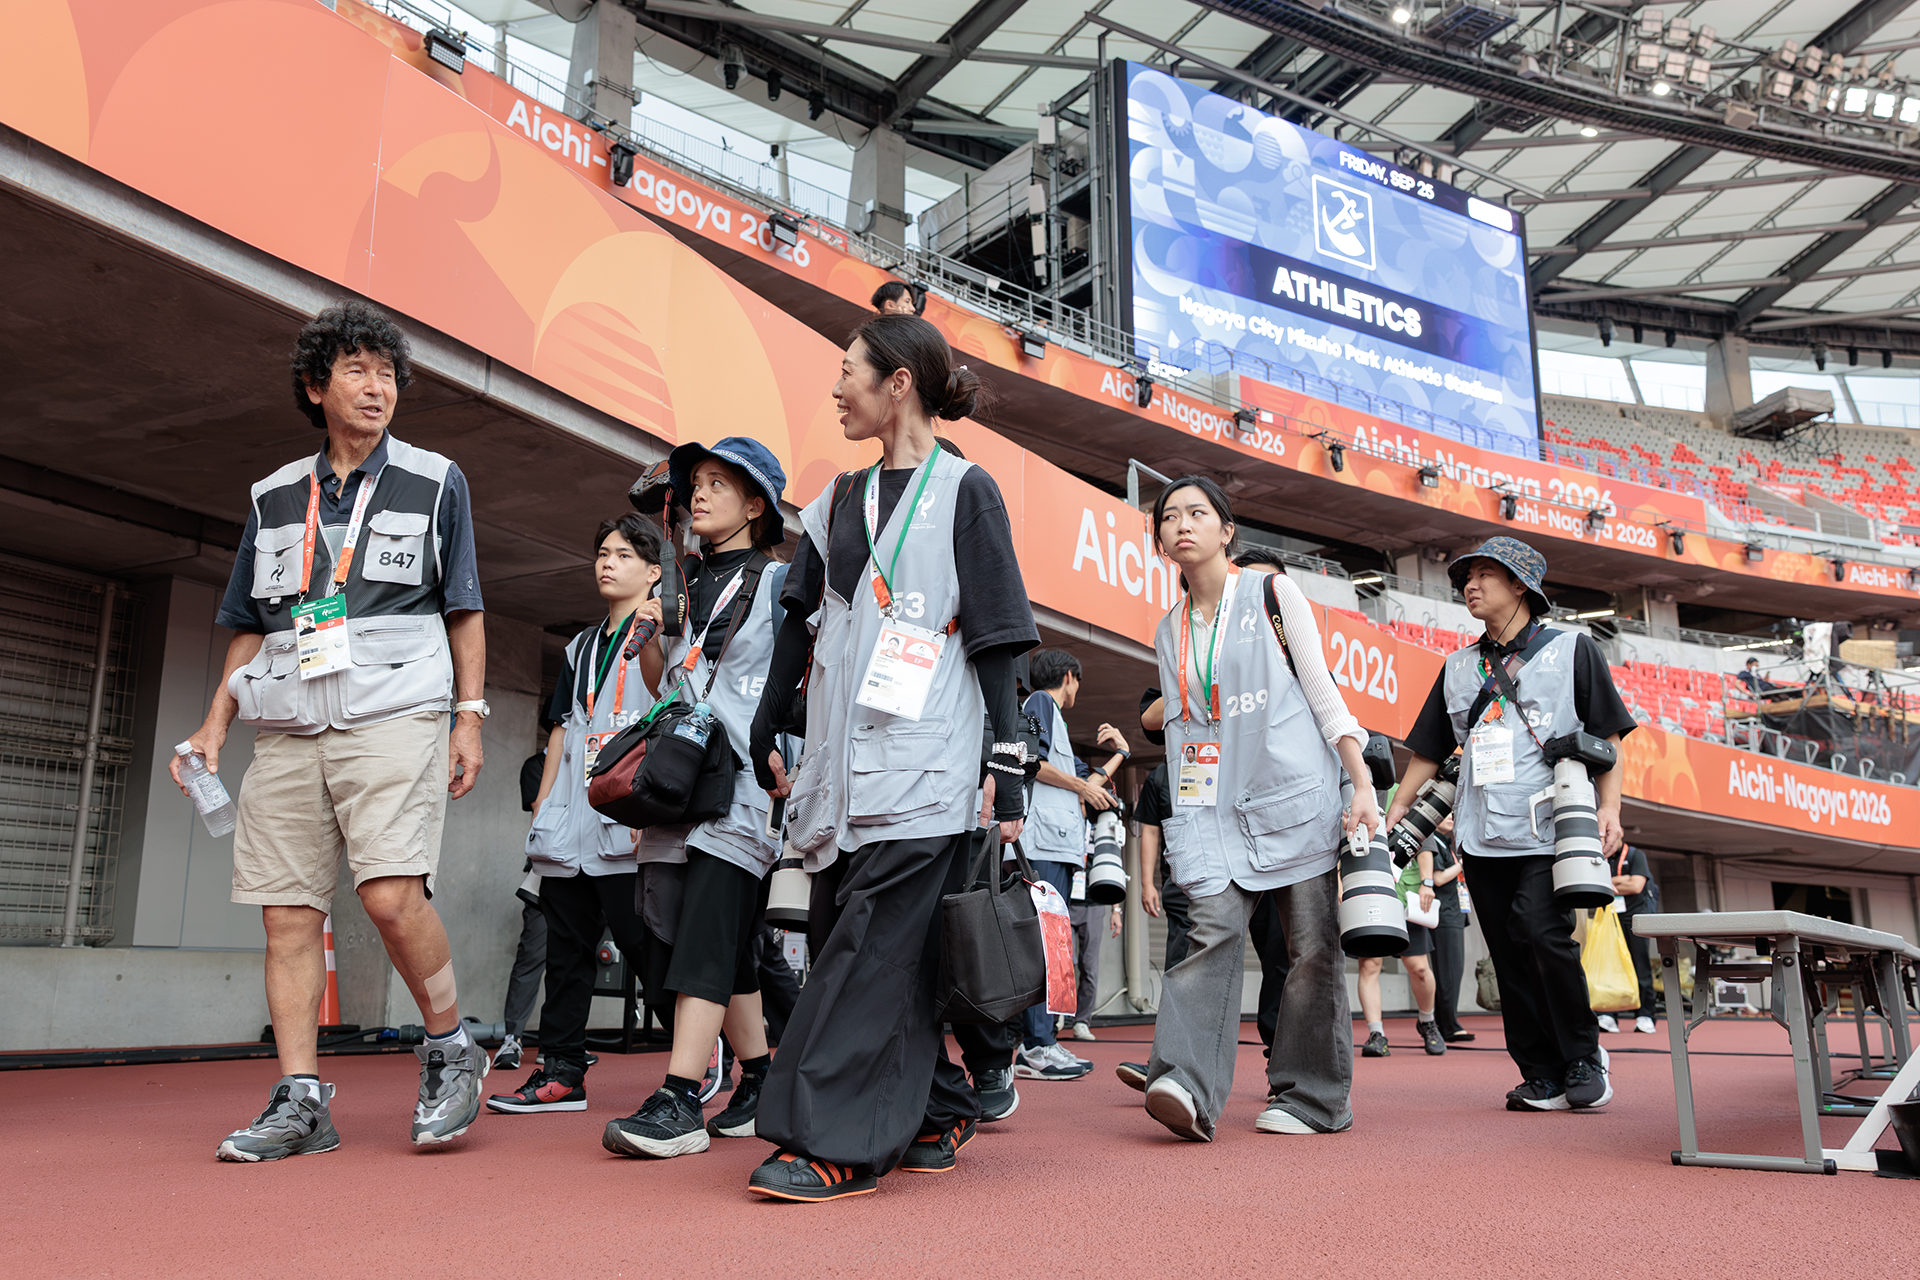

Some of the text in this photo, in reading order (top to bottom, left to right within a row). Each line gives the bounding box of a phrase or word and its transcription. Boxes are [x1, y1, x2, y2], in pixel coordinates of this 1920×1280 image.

[506, 99, 731, 233] Aichi-agoya
[1339, 150, 1435, 200] FRIDAY, SEP 25
[1272, 266, 1422, 338] ATHLETICS
[1179, 294, 1503, 404] Nagoya City Mizuho Park Athletic Stadium
[1100, 371, 1235, 440] Aic-Nagoya
[354, 489, 368, 522] Aichi-Nagoya
[363, 477, 373, 490] 2026
[1548, 478, 1616, 518] 2026
[1499, 499, 1657, 549] Achi-Nagoya 2026
[378, 551, 416, 569] 847
[677, 593, 686, 624] Canon
[1272, 614, 1287, 646] Canon
[913, 657, 923, 665] EP
[1331, 631, 1398, 704] 2026
[607, 710, 641, 728] 156
[1226, 689, 1268, 718] 289
[1728, 758, 1891, 826] Aichi-Nagoya 2026
